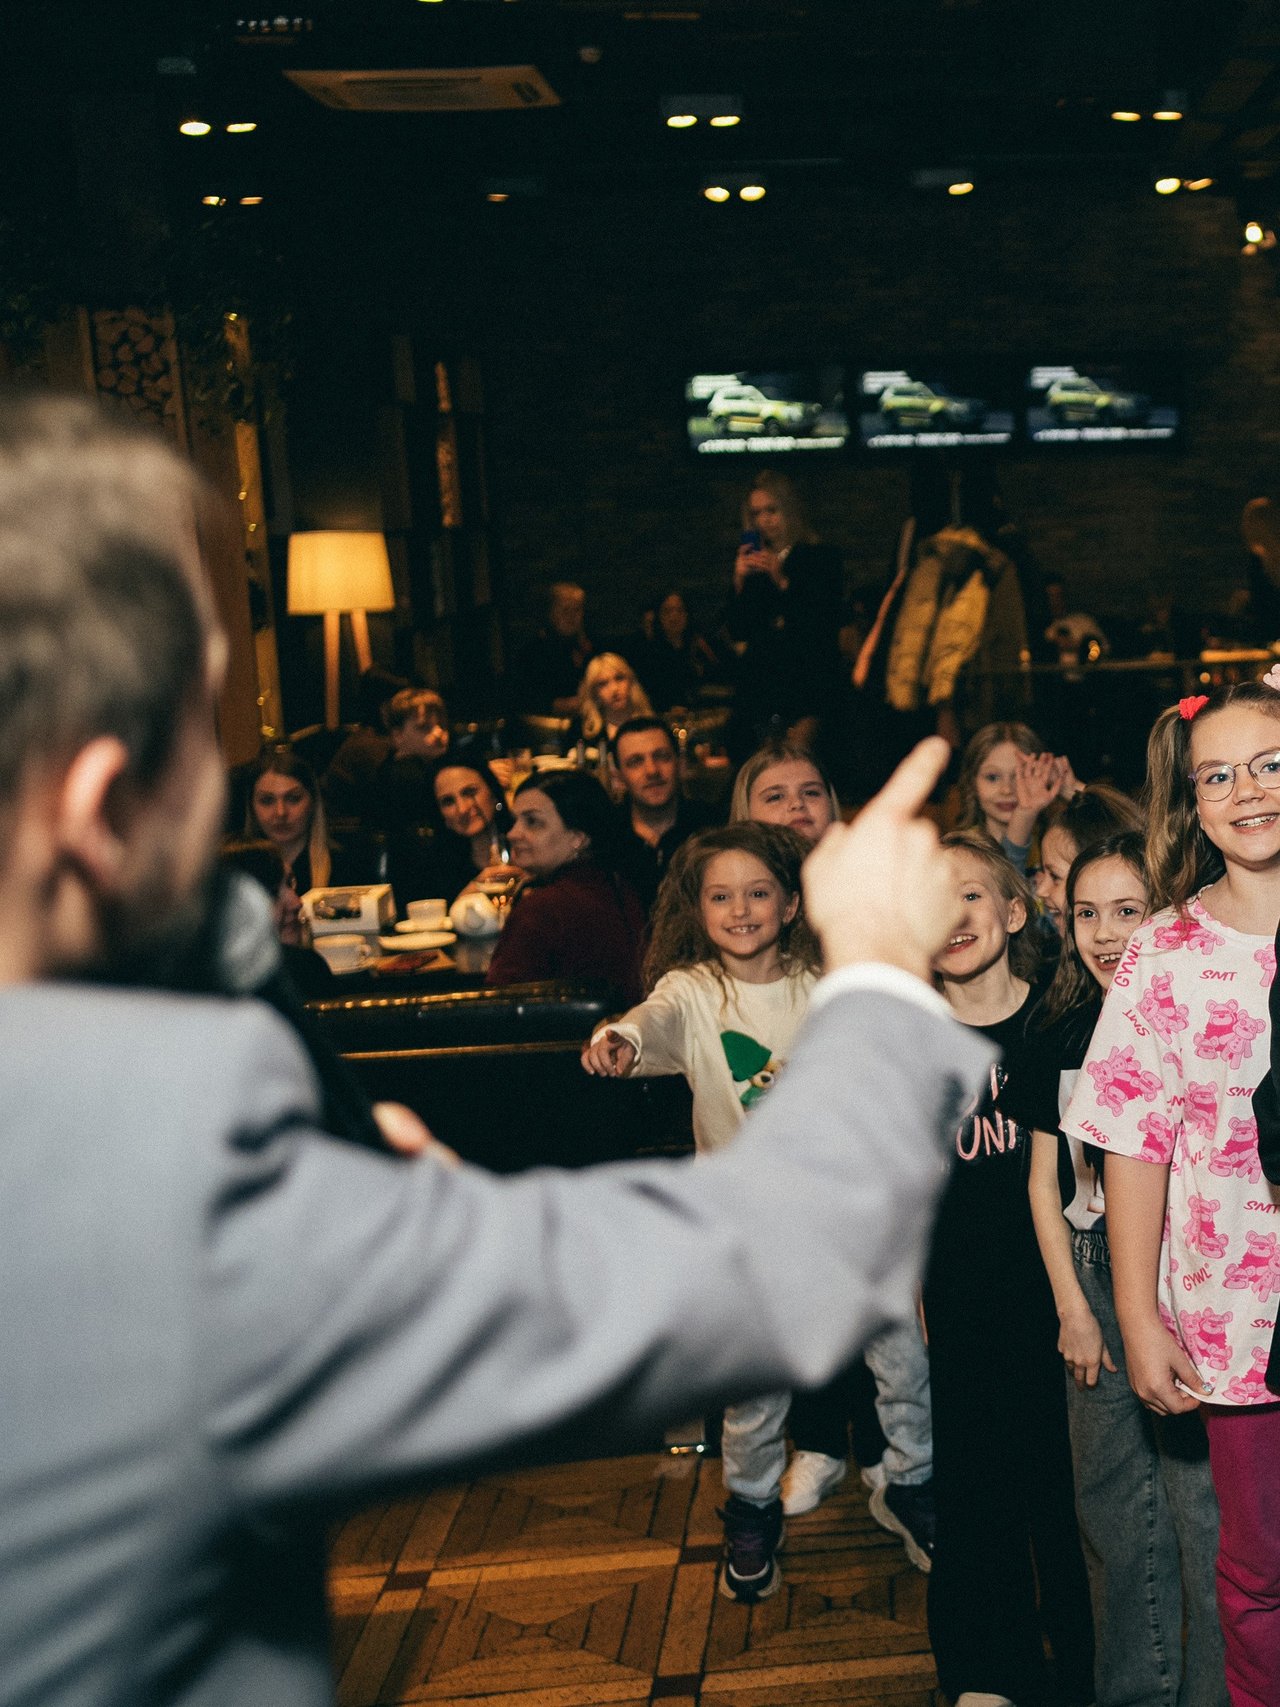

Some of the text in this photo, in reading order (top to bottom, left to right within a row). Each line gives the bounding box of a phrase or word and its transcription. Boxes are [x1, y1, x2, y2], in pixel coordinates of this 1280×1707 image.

[1199, 969, 1237, 982] SMT
[1122, 1009, 1150, 1037] SMT
[1225, 1086, 1257, 1098] SM
[1078, 1120, 1110, 1143] SMT
[1243, 1201, 1280, 1214] SMT
